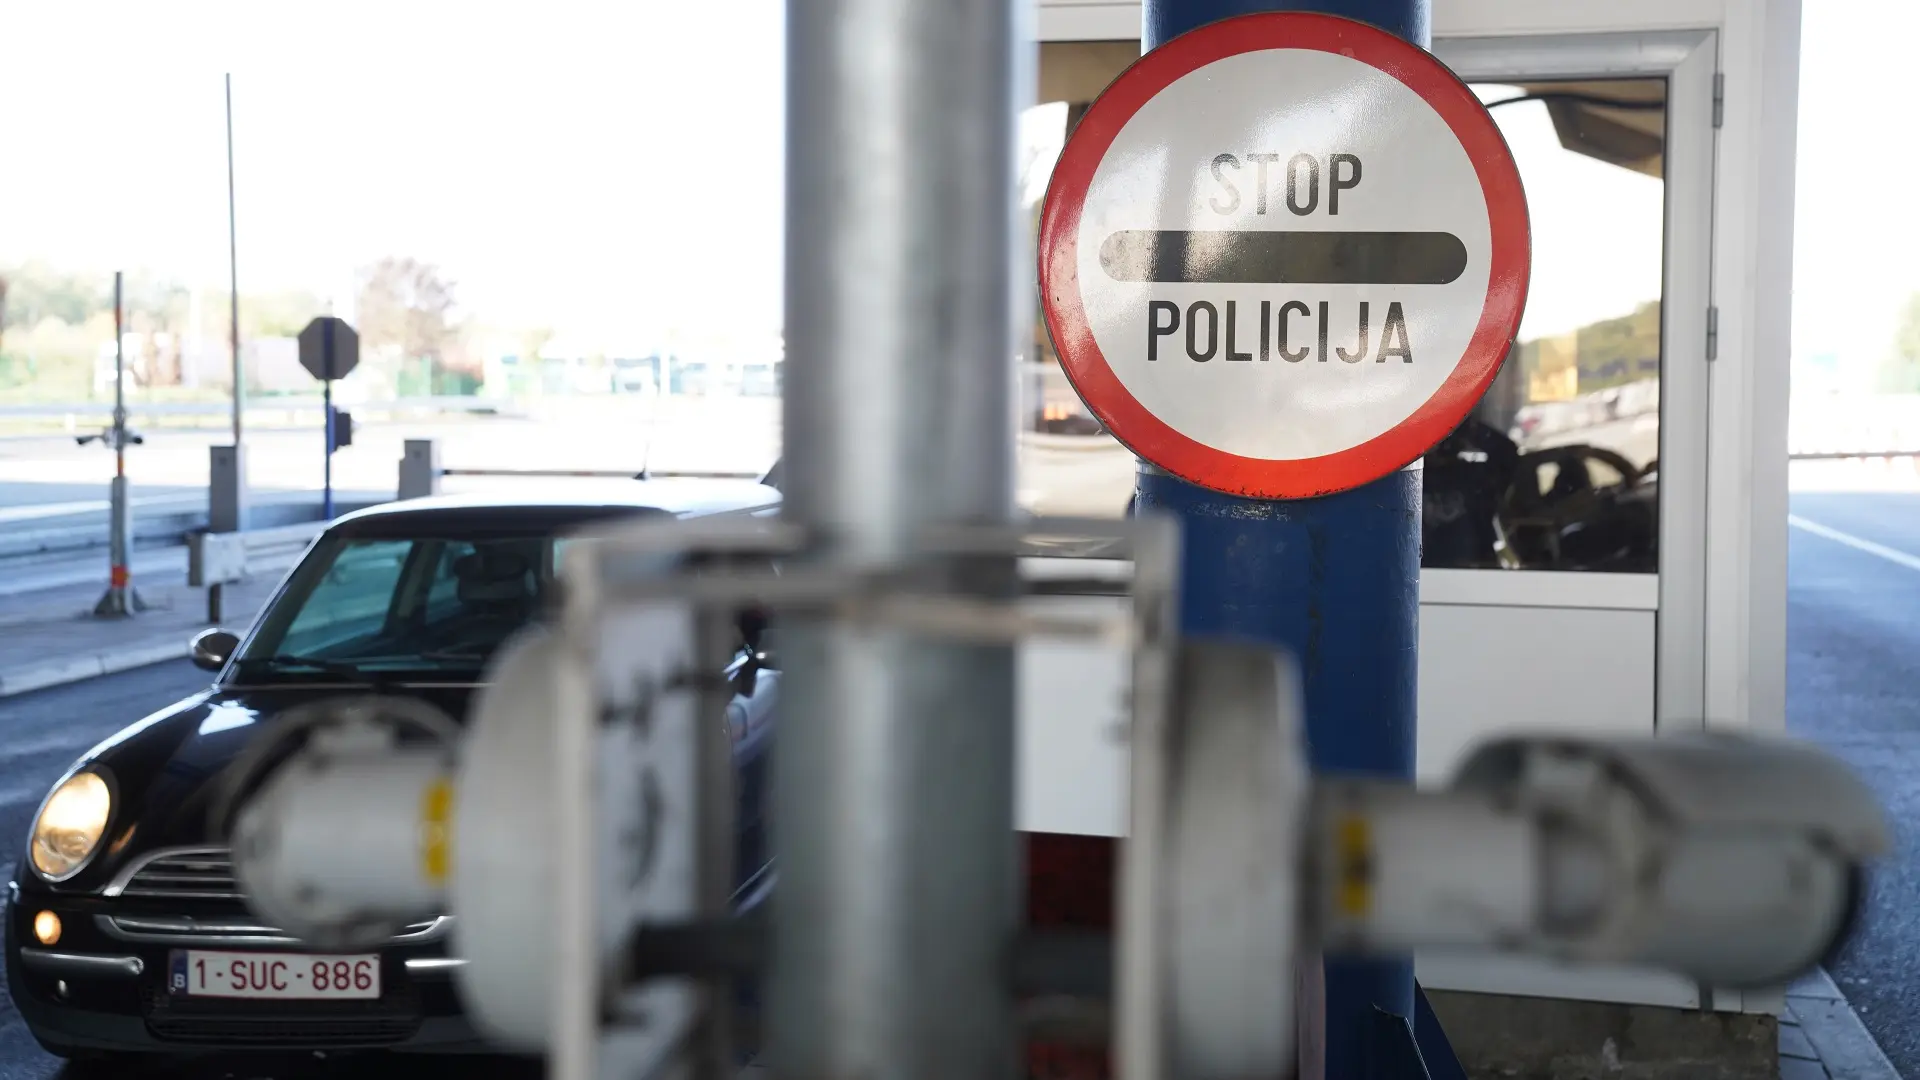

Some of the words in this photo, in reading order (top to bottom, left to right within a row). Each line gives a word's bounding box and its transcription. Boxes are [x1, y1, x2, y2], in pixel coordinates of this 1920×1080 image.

[1209, 153, 1362, 216] STOP
[1147, 300, 1413, 363] POLICIJA
[173, 973, 186, 989] B
[195, 958, 372, 991] 1-SUC-886
